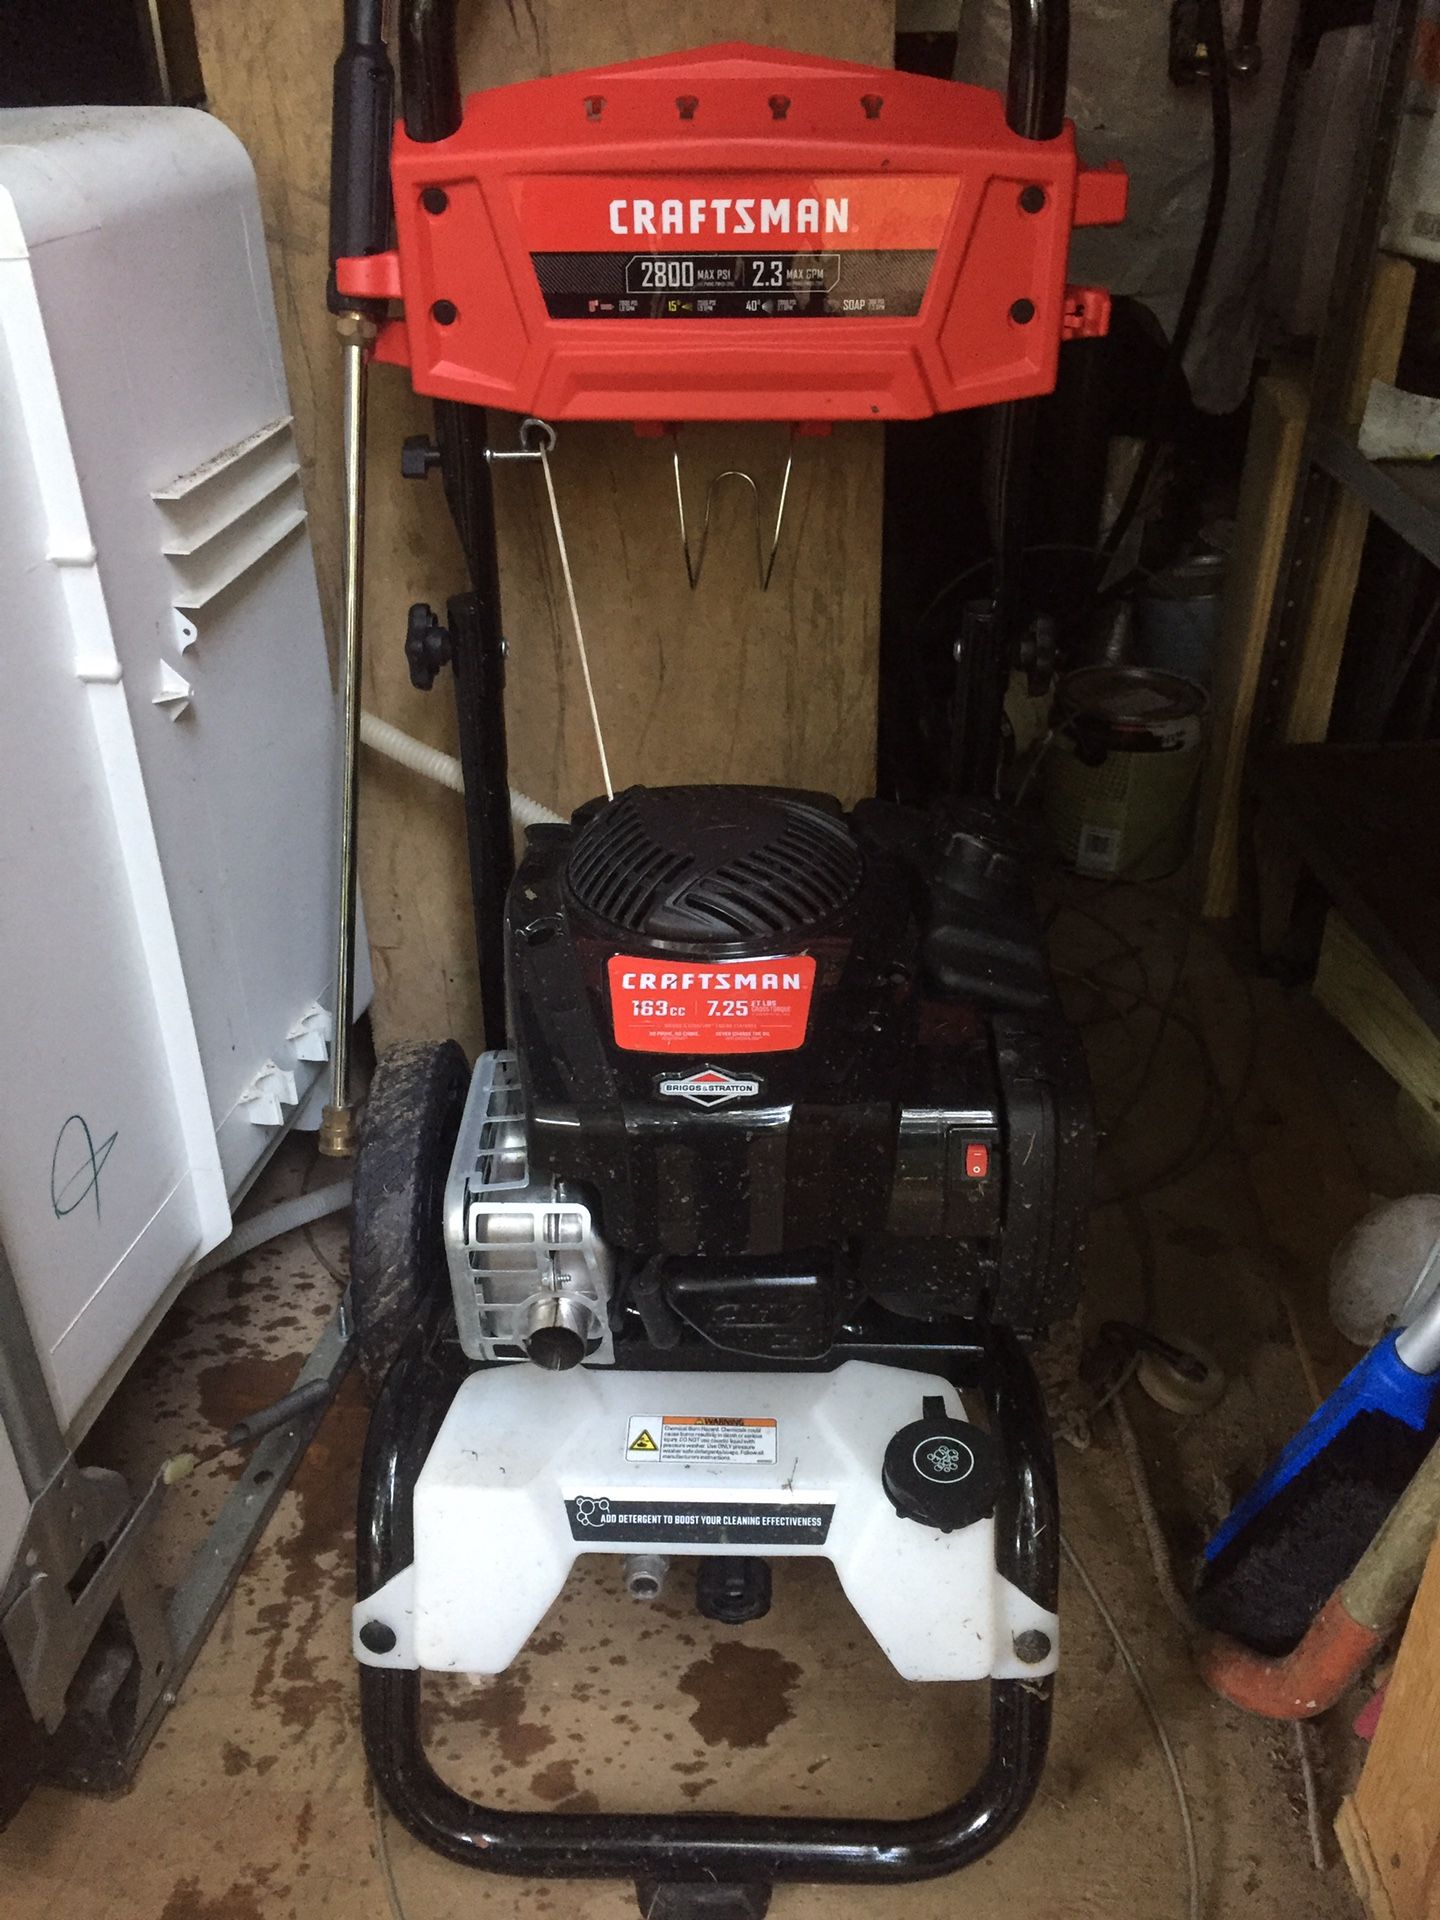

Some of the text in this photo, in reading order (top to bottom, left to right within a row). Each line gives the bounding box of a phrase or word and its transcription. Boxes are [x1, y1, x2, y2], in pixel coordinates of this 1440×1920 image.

[609, 198, 849, 235] CRAFTSMAN
[640, 261, 694, 288] 2800
[697, 269, 714, 280] MAX
[716, 269, 731, 280] PSI
[752, 260, 783, 288] 2.3
[786, 269, 804, 280] MAX
[806, 268, 824, 280] GPM
[843, 298, 866, 311] SOAP
[622, 973, 801, 990] CRAFTSMAN
[707, 1000, 749, 1017] 7.25
[704, 1418, 744, 1426] WARNING
[600, 1514, 822, 1527] ADD DETERGENT TO BOOST YOUR CLEANING EFFECTIVENESS
